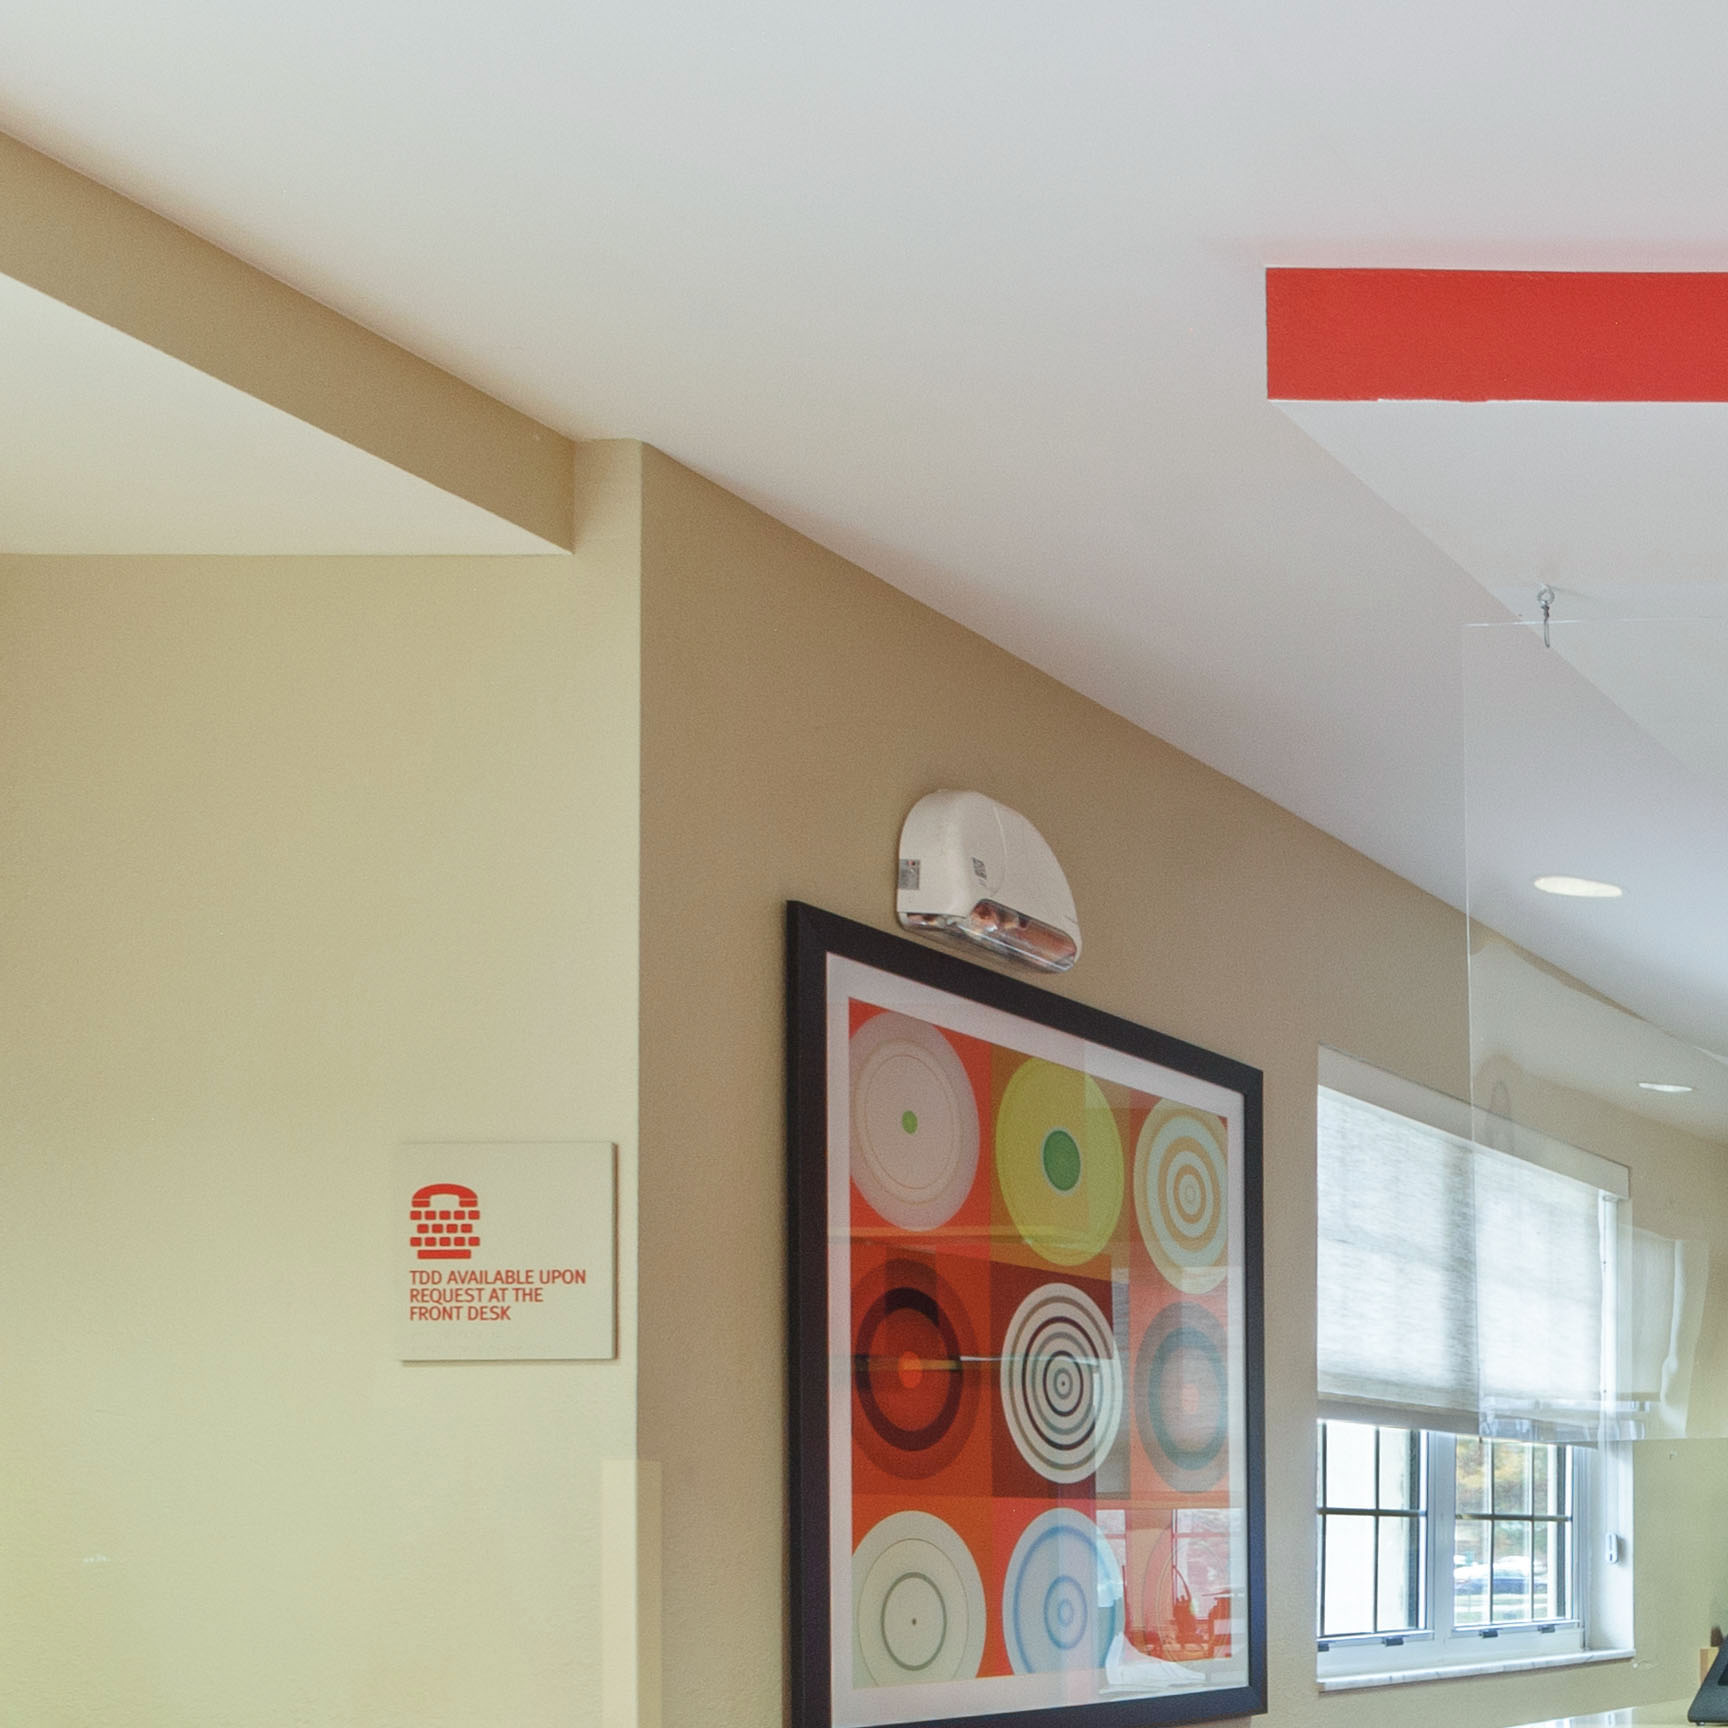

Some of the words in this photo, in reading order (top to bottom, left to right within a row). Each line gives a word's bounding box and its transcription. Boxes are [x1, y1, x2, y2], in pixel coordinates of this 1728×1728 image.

[409, 1270, 442, 1285] TDD
[446, 1269, 534, 1285] AVAILABLE
[539, 1269, 587, 1285] UPON
[410, 1288, 483, 1304] REQUEST
[488, 1288, 509, 1302] AT
[512, 1288, 544, 1302] THE
[410, 1306, 463, 1321] FRONT
[467, 1306, 511, 1321] DESK
